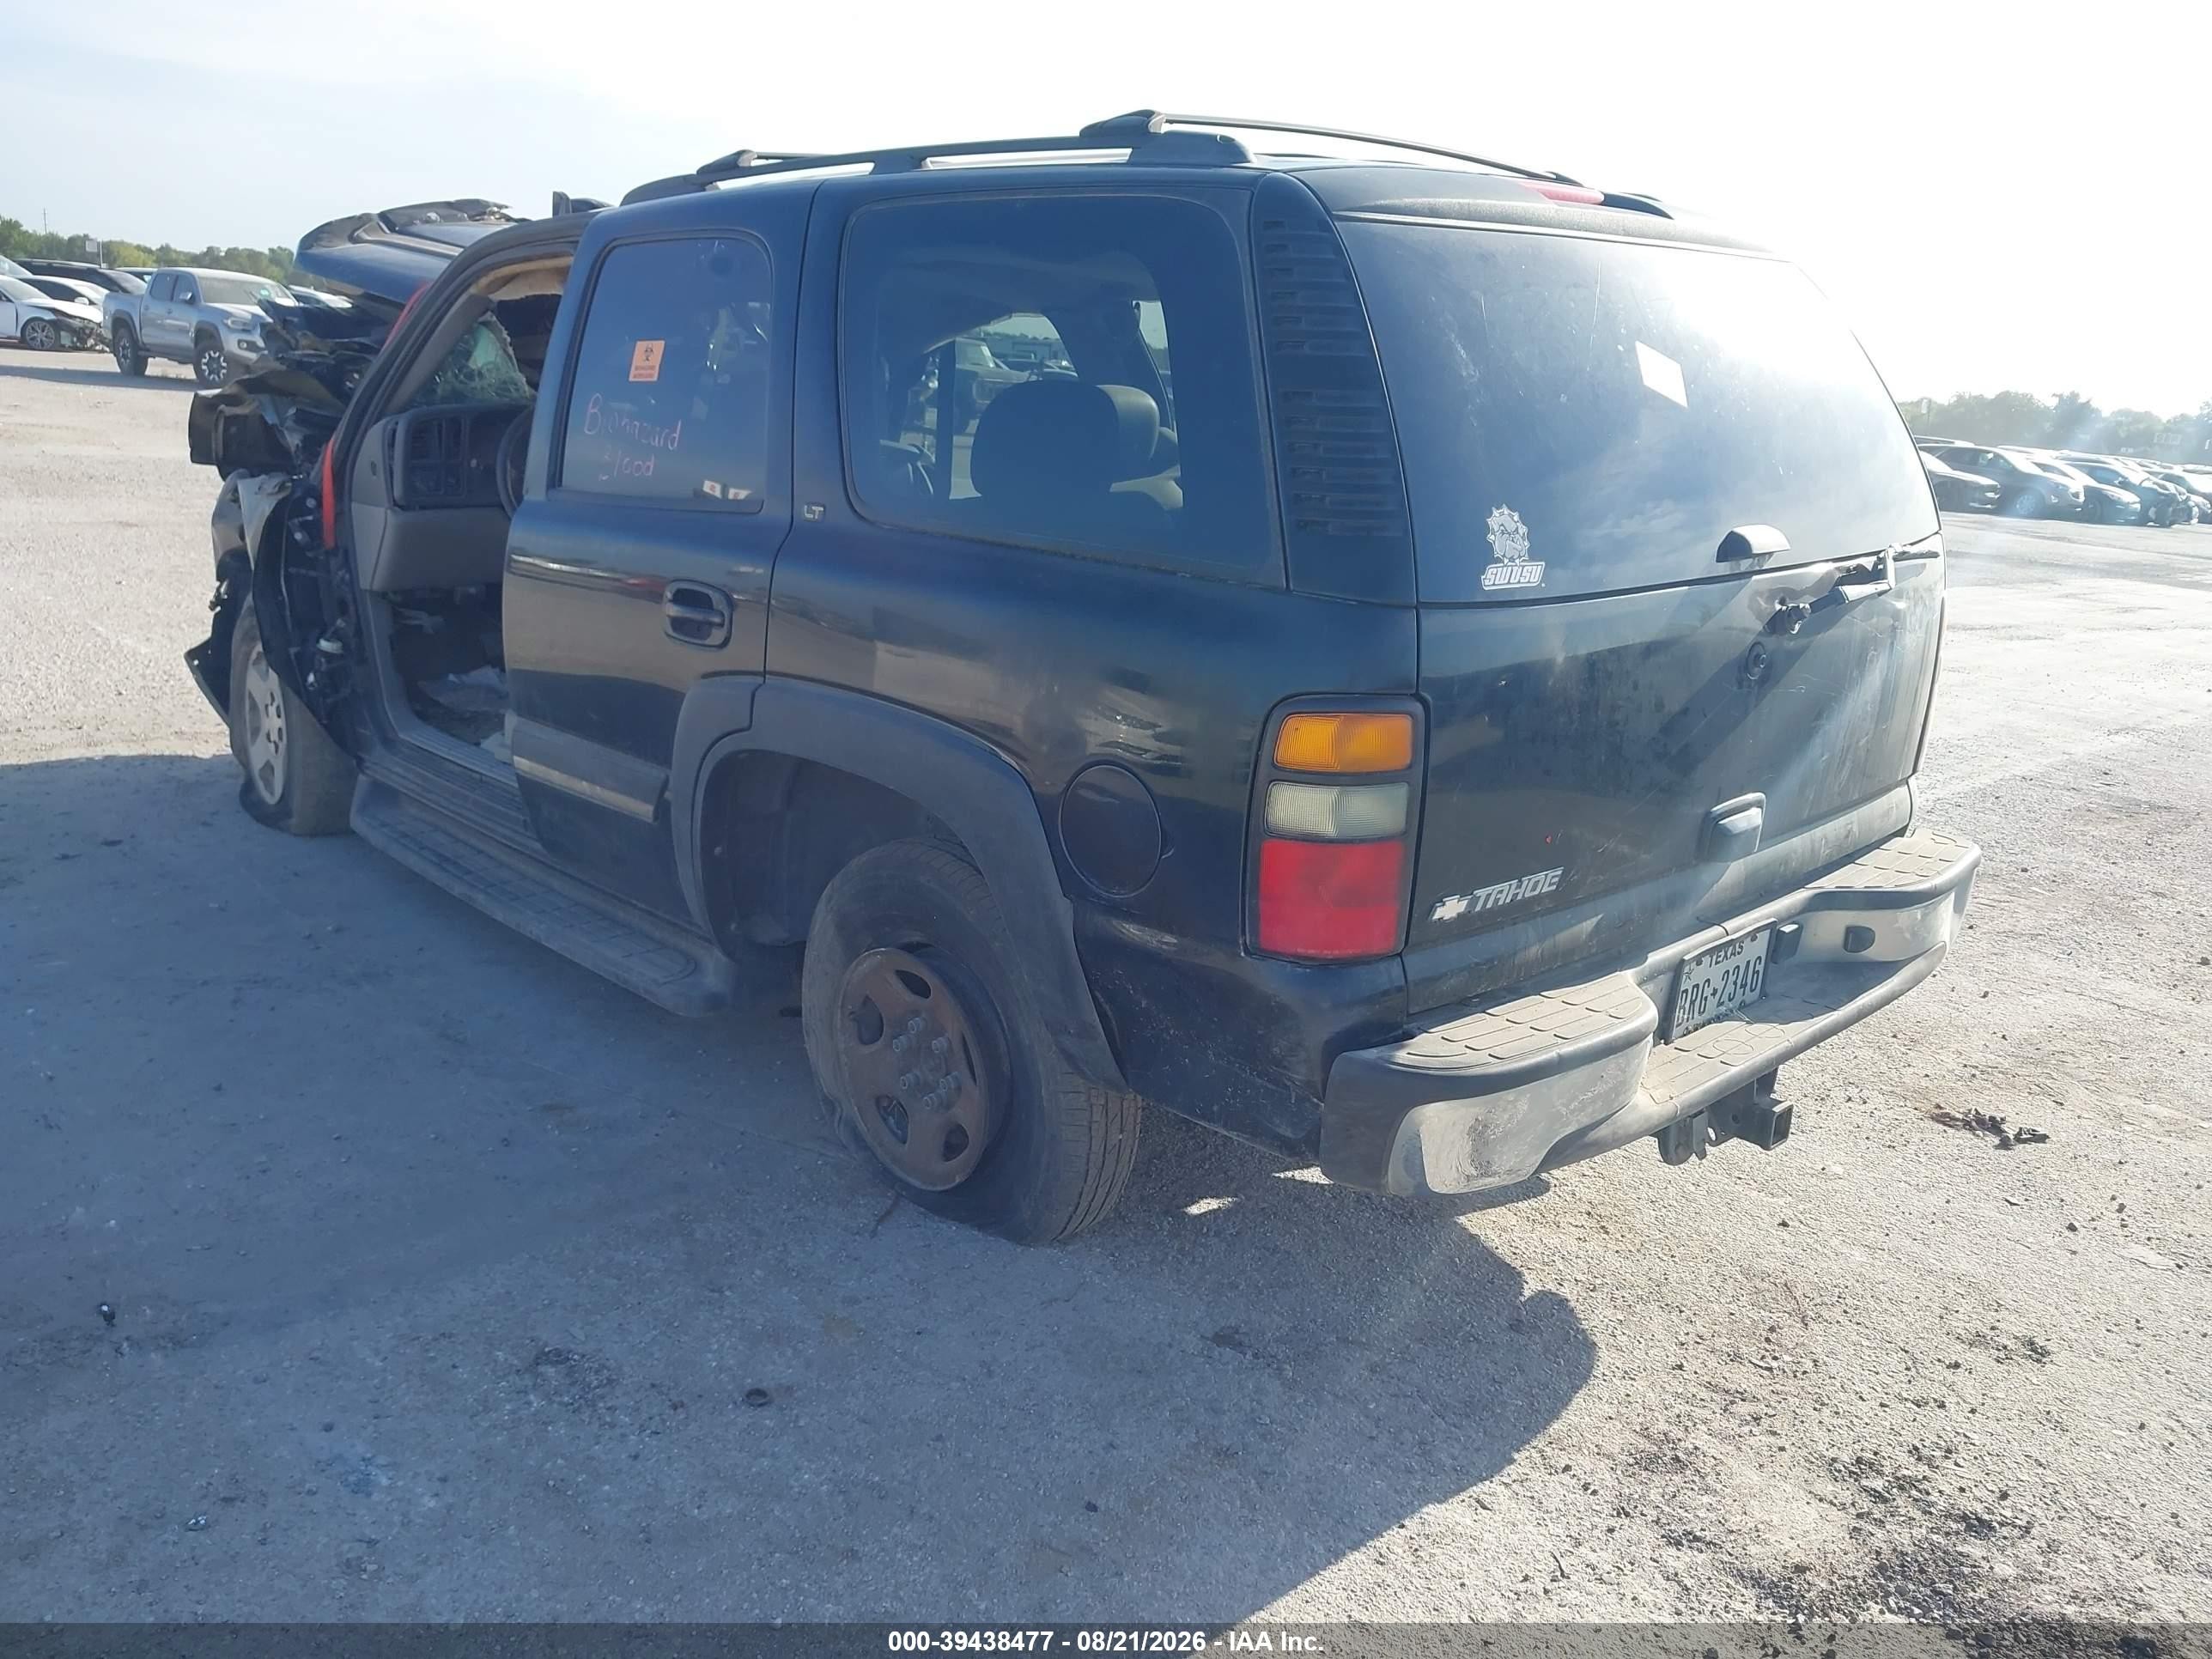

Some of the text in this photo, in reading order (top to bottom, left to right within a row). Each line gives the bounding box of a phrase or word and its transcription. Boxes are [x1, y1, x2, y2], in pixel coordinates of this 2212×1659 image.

[804, 505, 824, 520] LT
[1473, 867, 1564, 913] TAHOE
[1709, 940, 1744, 969] TEXAS
